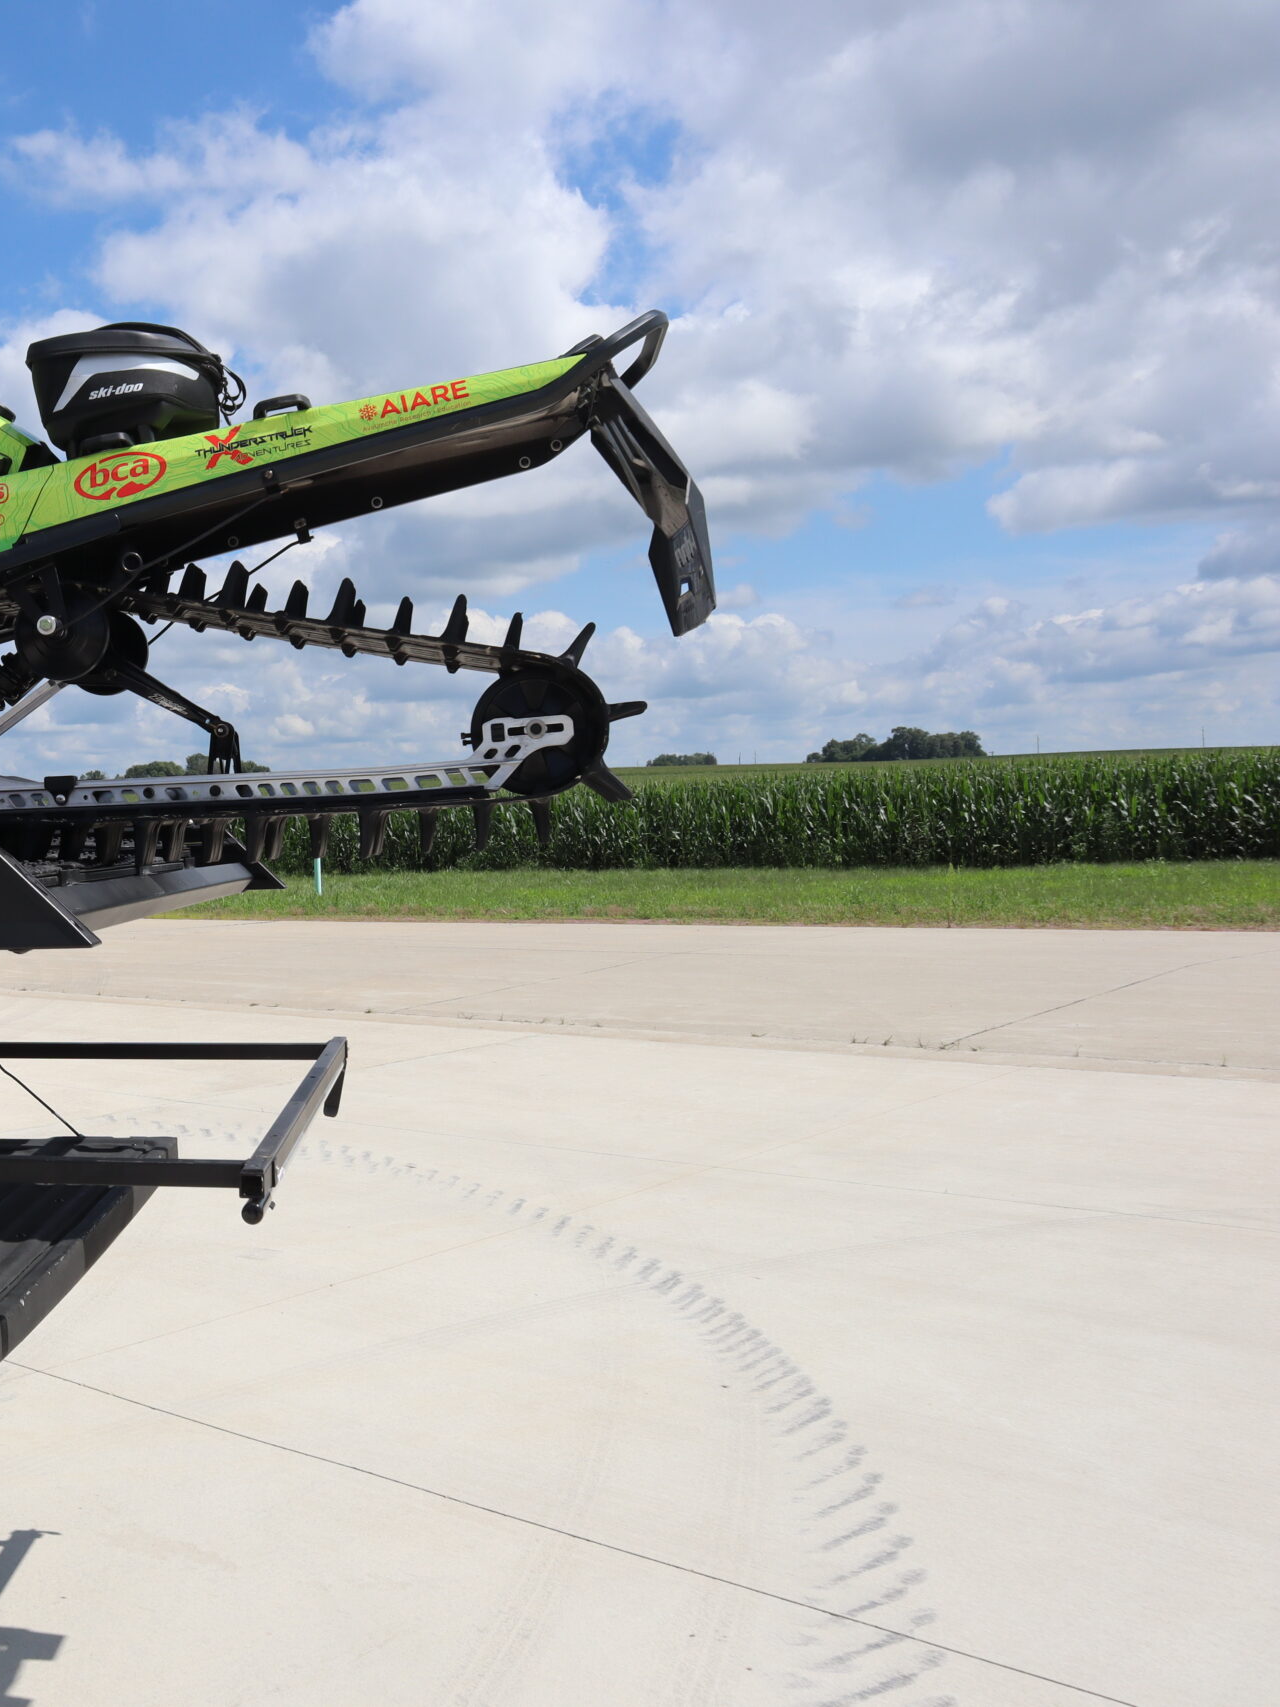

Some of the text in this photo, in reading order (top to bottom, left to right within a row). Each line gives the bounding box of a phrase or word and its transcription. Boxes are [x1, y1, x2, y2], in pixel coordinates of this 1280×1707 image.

[88, 382, 144, 400] ski-doo
[380, 380, 470, 418] AIARE
[195, 425, 313, 459] THUNDERSTRUCK
[89, 458, 149, 488] bca
